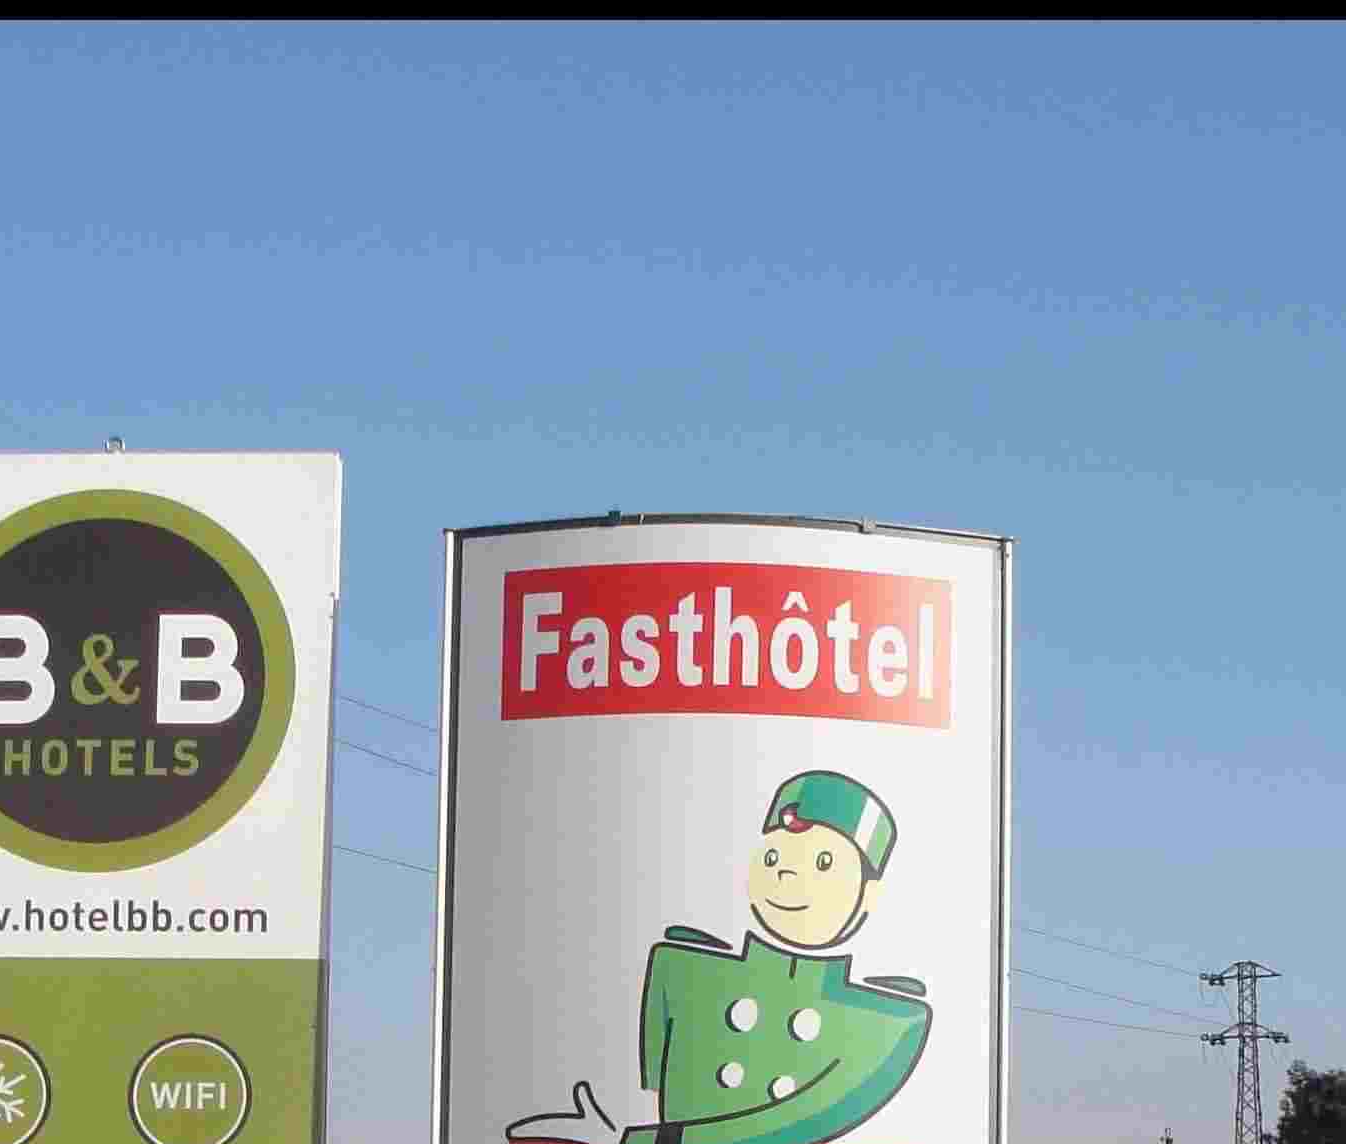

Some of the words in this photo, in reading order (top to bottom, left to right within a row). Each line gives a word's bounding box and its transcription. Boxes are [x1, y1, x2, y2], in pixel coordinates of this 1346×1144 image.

[518, 586, 934, 700] Fasthôtel
[3, 739, 199, 777] HOTELS
[150, 1082, 227, 1111] WIFI
